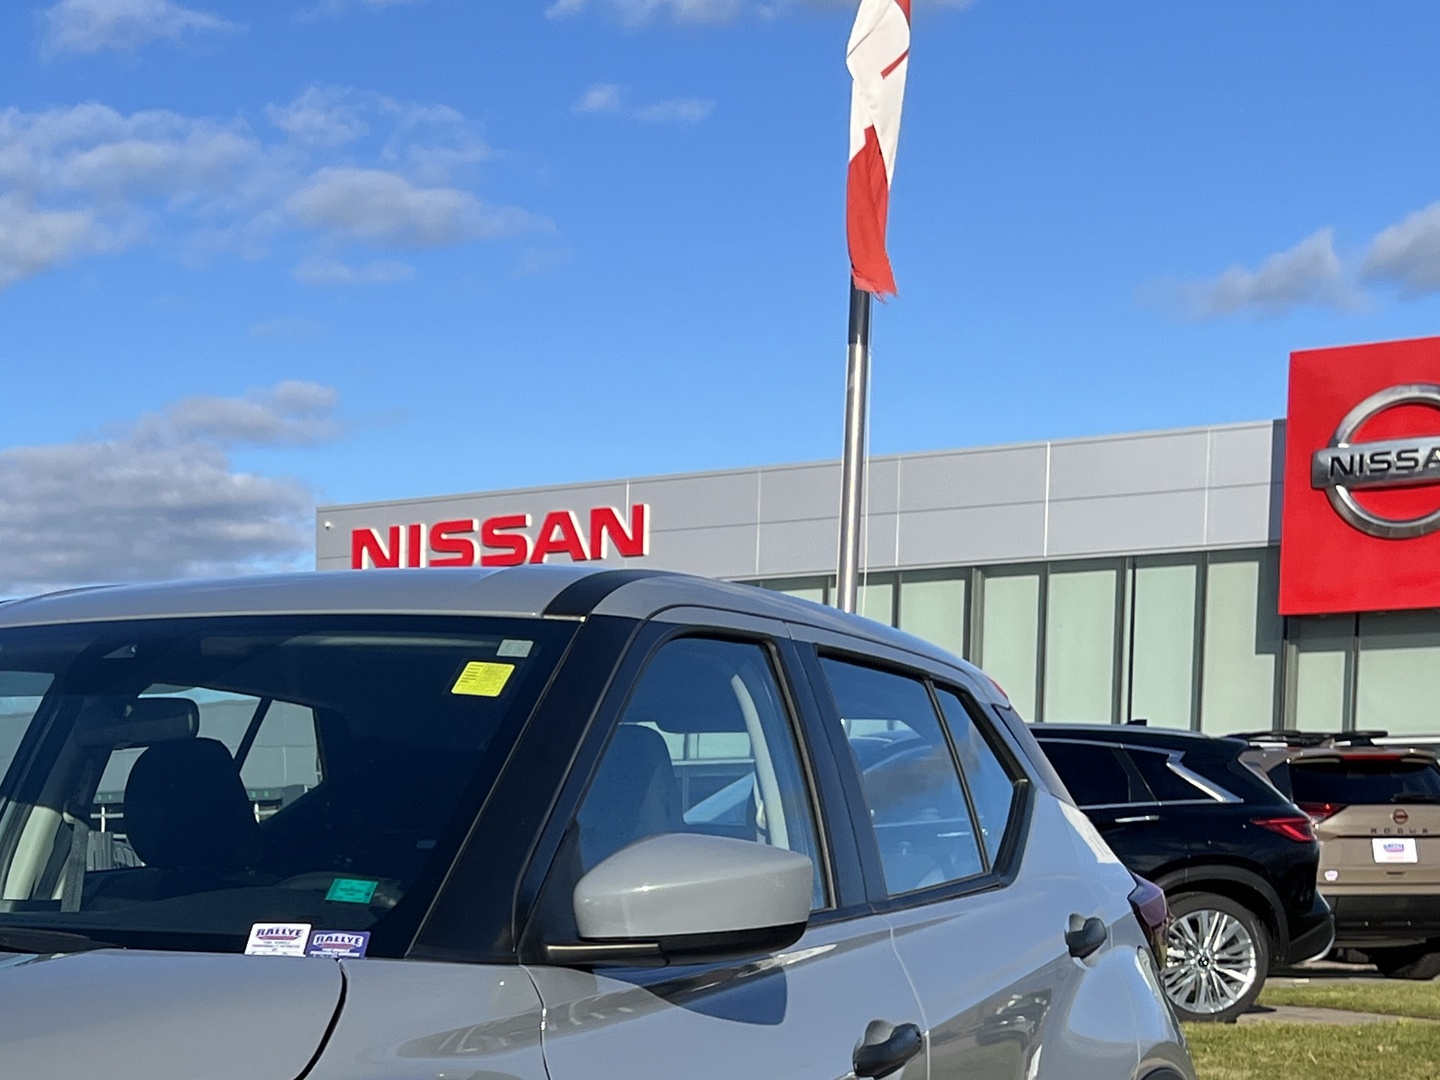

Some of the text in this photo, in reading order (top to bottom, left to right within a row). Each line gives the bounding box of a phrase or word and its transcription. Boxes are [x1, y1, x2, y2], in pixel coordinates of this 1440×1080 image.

[351, 503, 650, 570] NISSAN
[256, 928, 304, 938] RALLYE
[315, 935, 362, 945] RALLYE
